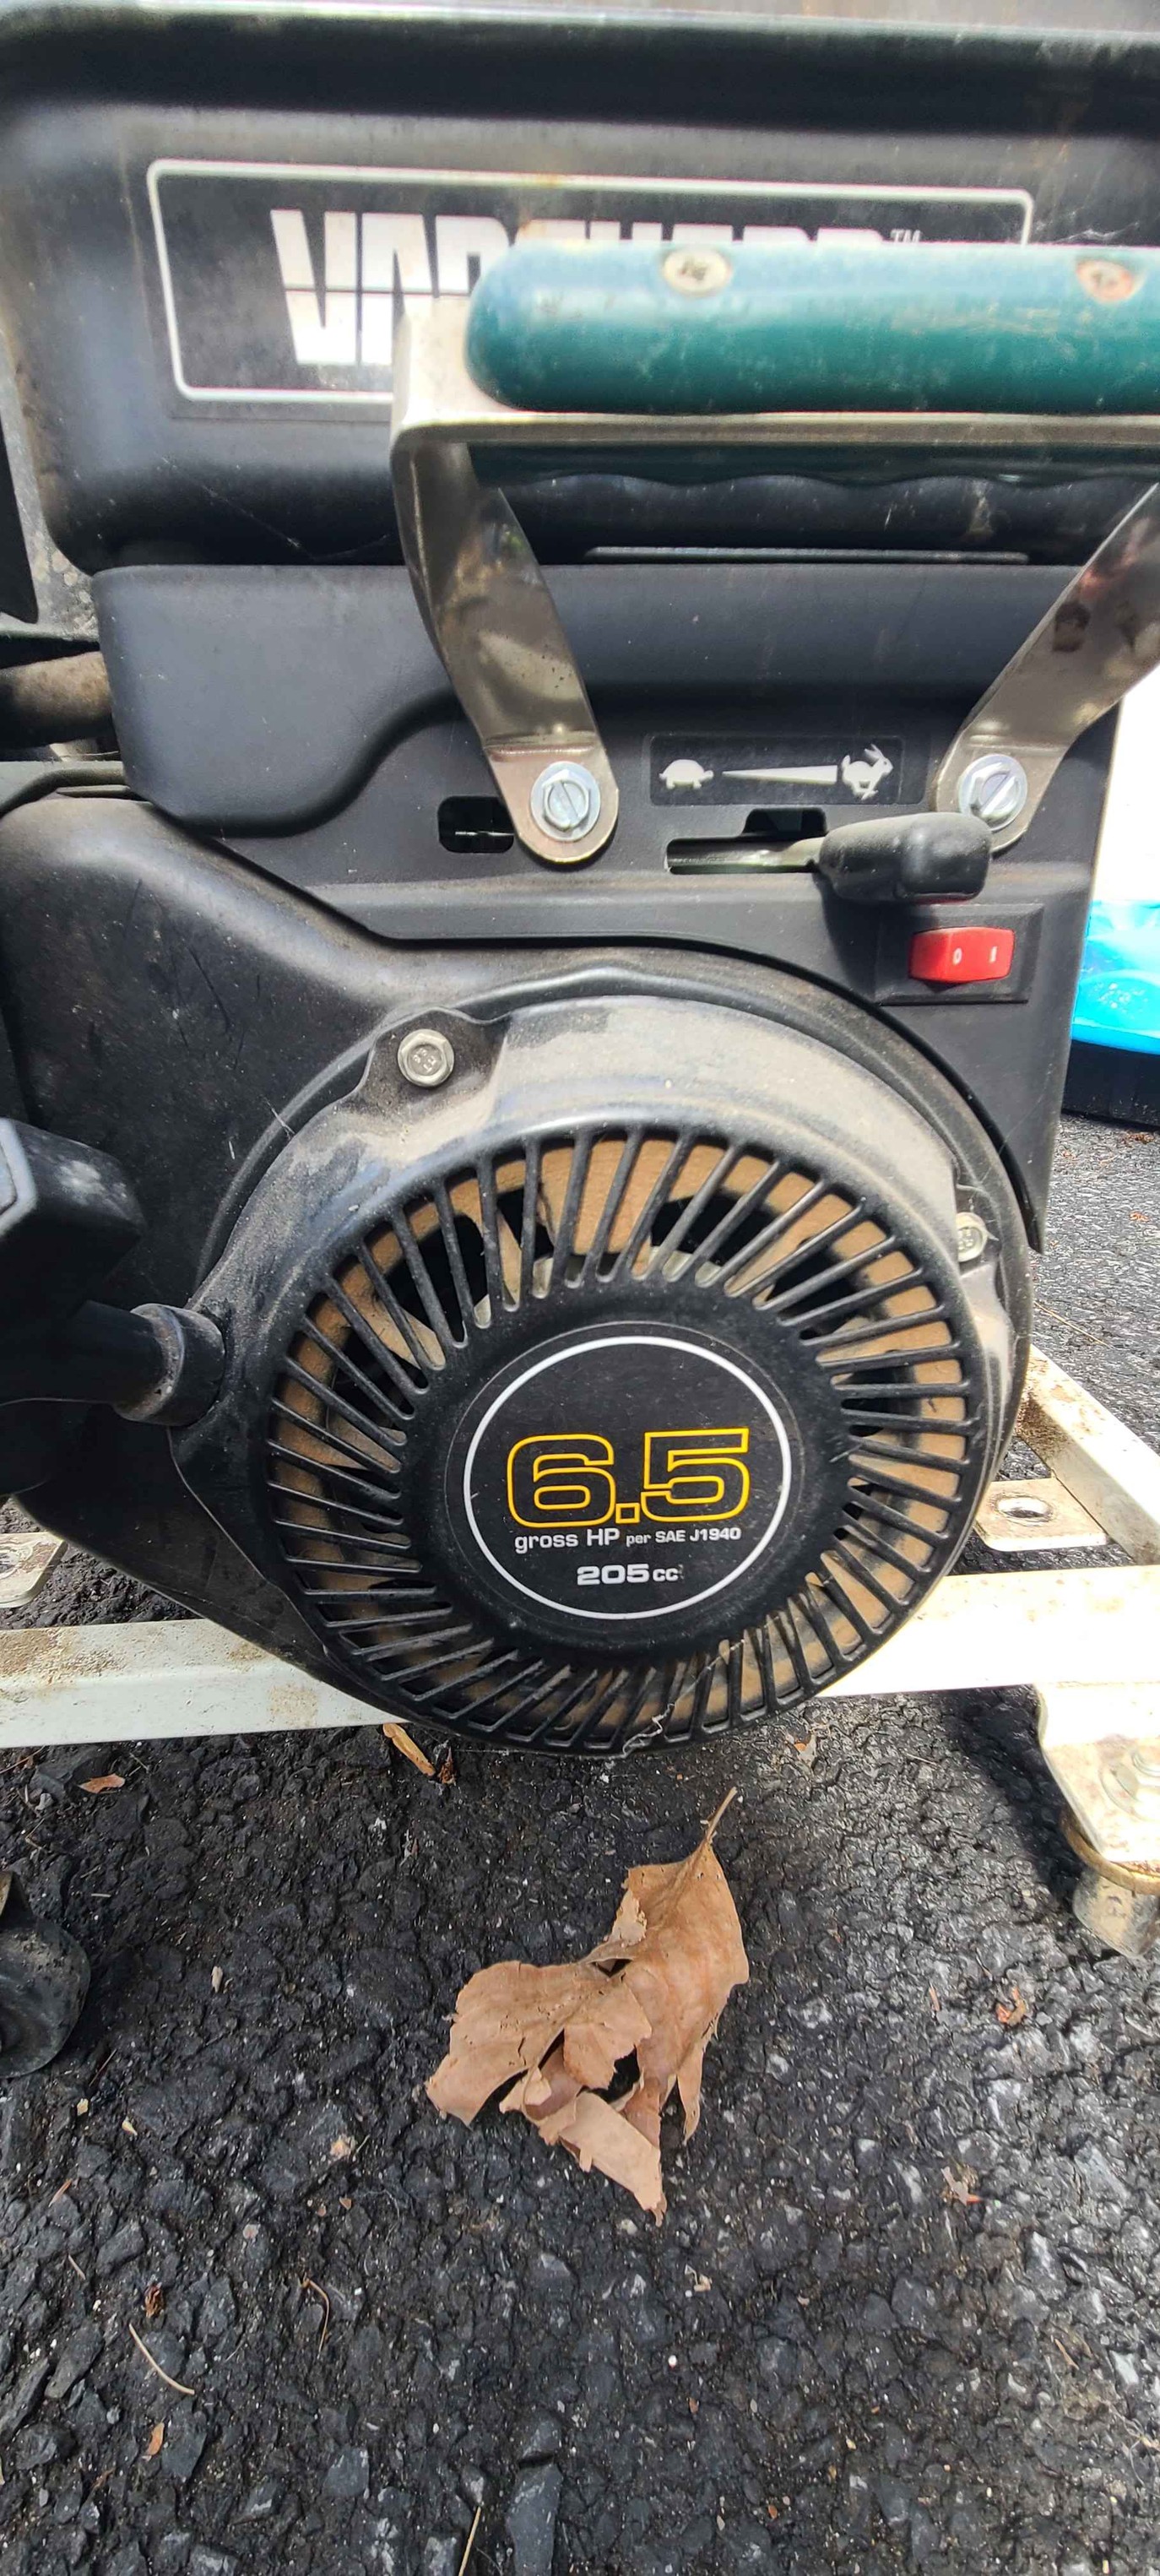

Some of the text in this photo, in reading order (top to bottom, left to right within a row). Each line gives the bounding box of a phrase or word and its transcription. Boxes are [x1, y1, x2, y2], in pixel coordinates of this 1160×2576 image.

[507, 1428, 751, 1528] 6.5
[514, 1527, 742, 1554] gross HP per SAE J1940
